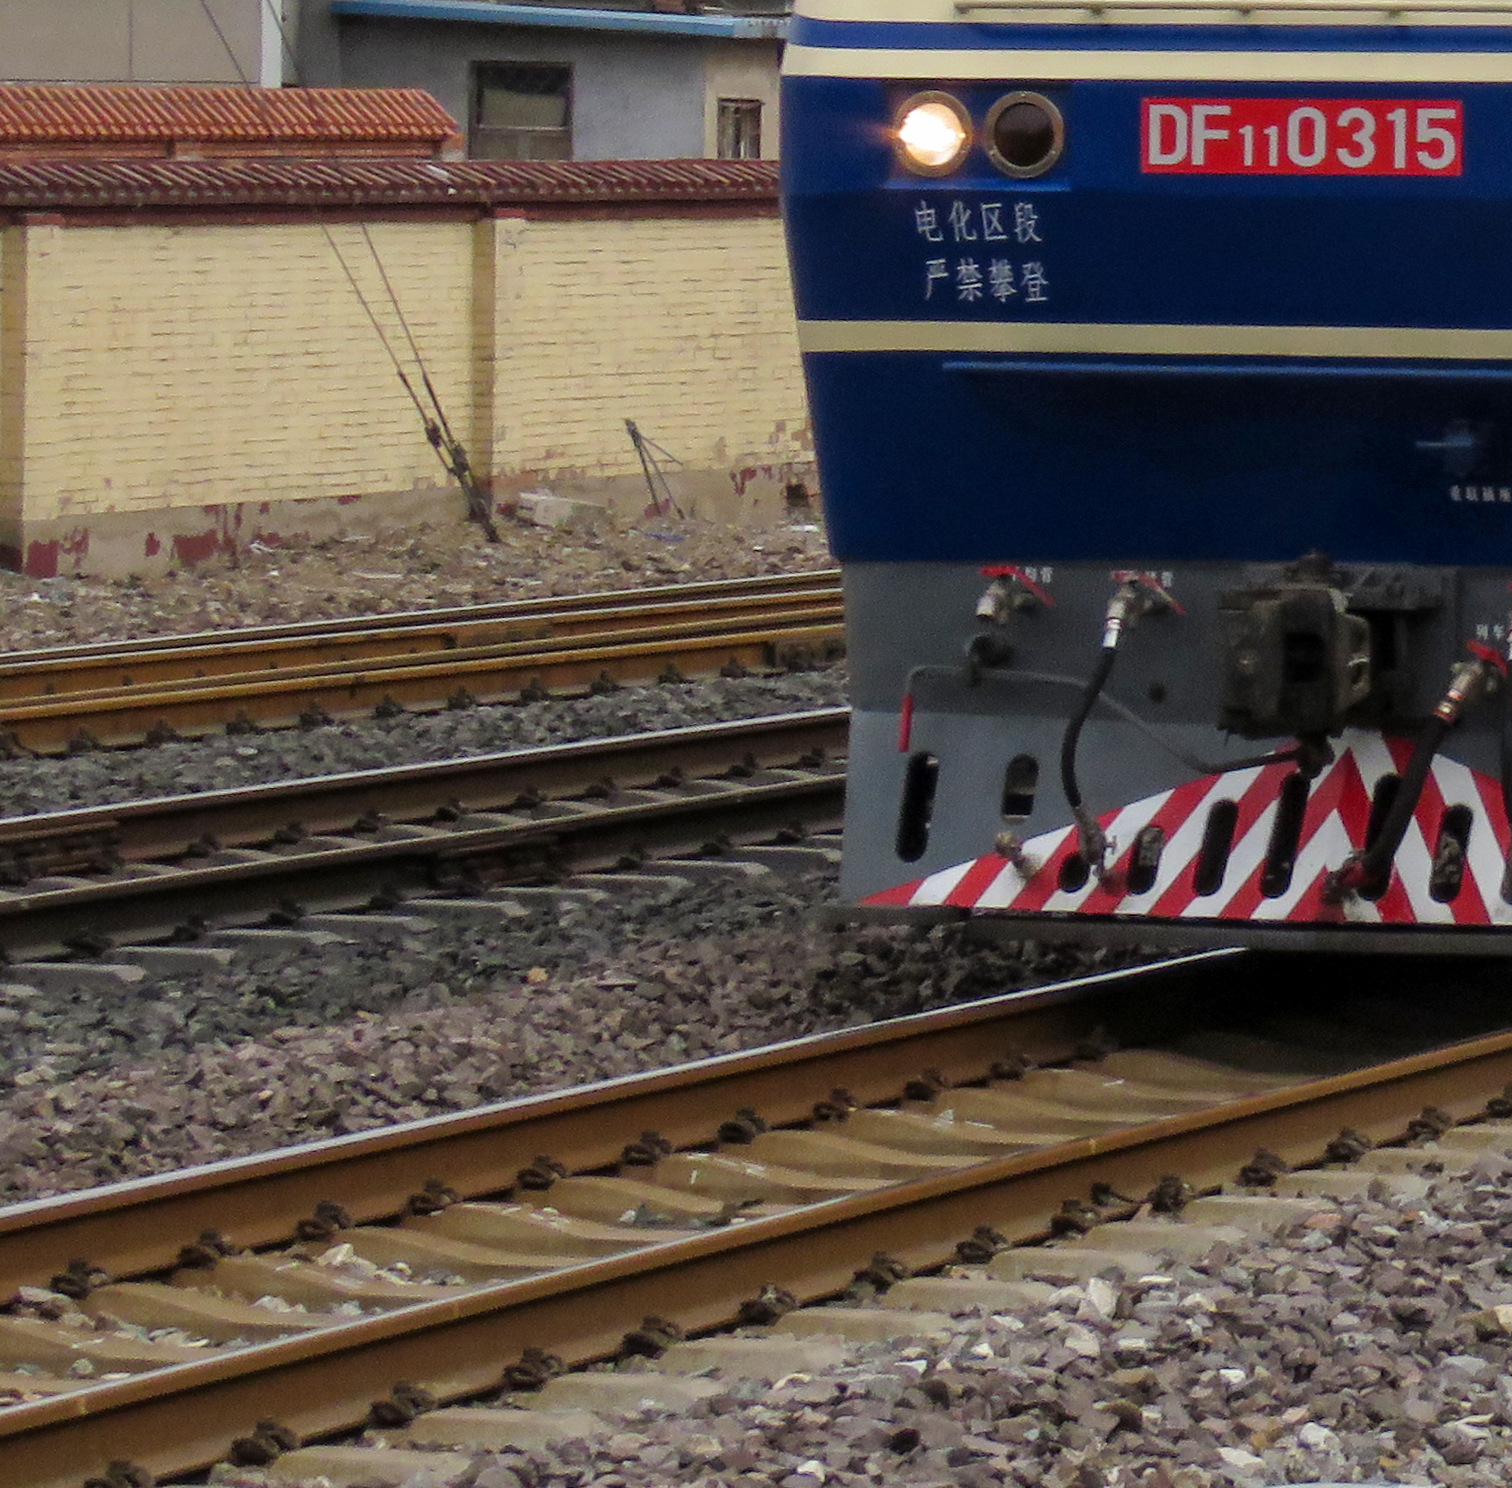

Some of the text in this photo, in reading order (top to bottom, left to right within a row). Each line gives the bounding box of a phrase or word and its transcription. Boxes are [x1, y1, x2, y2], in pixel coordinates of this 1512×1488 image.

[914, 200, 1042, 243] 电化区段
[926, 258, 1048, 302] 严禁攀登
